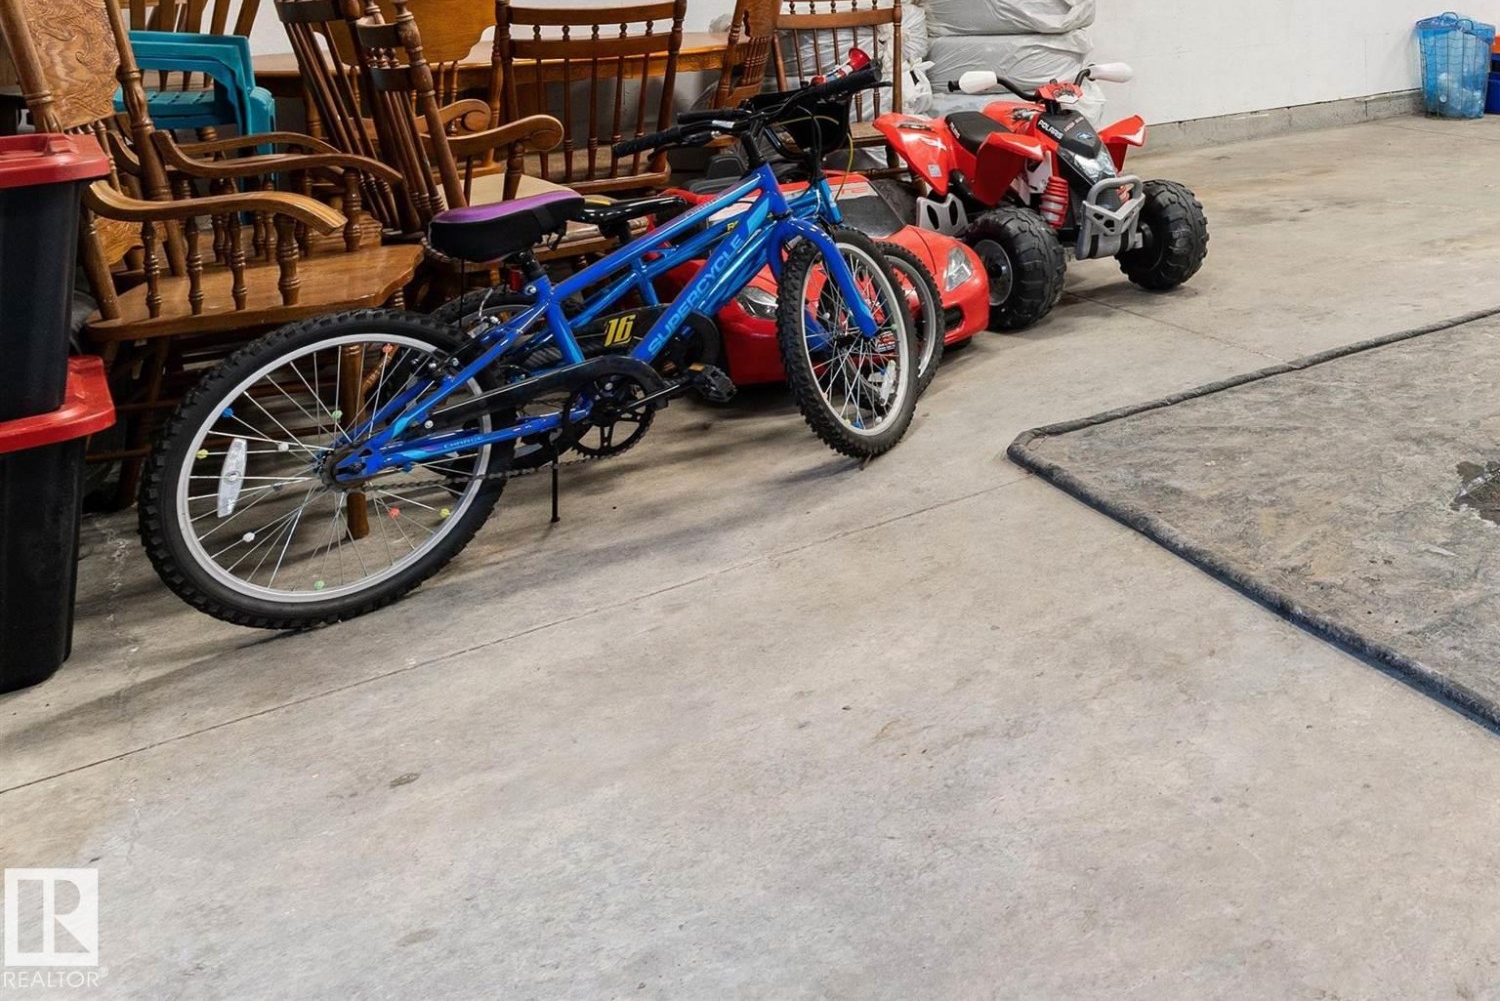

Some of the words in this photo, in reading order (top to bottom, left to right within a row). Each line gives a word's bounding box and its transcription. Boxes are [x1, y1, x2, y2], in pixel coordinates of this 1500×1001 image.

[1037, 119, 1064, 140] POLARIS
[648, 234, 744, 355] SUPERCYCLE
[604, 313, 637, 347] 16
